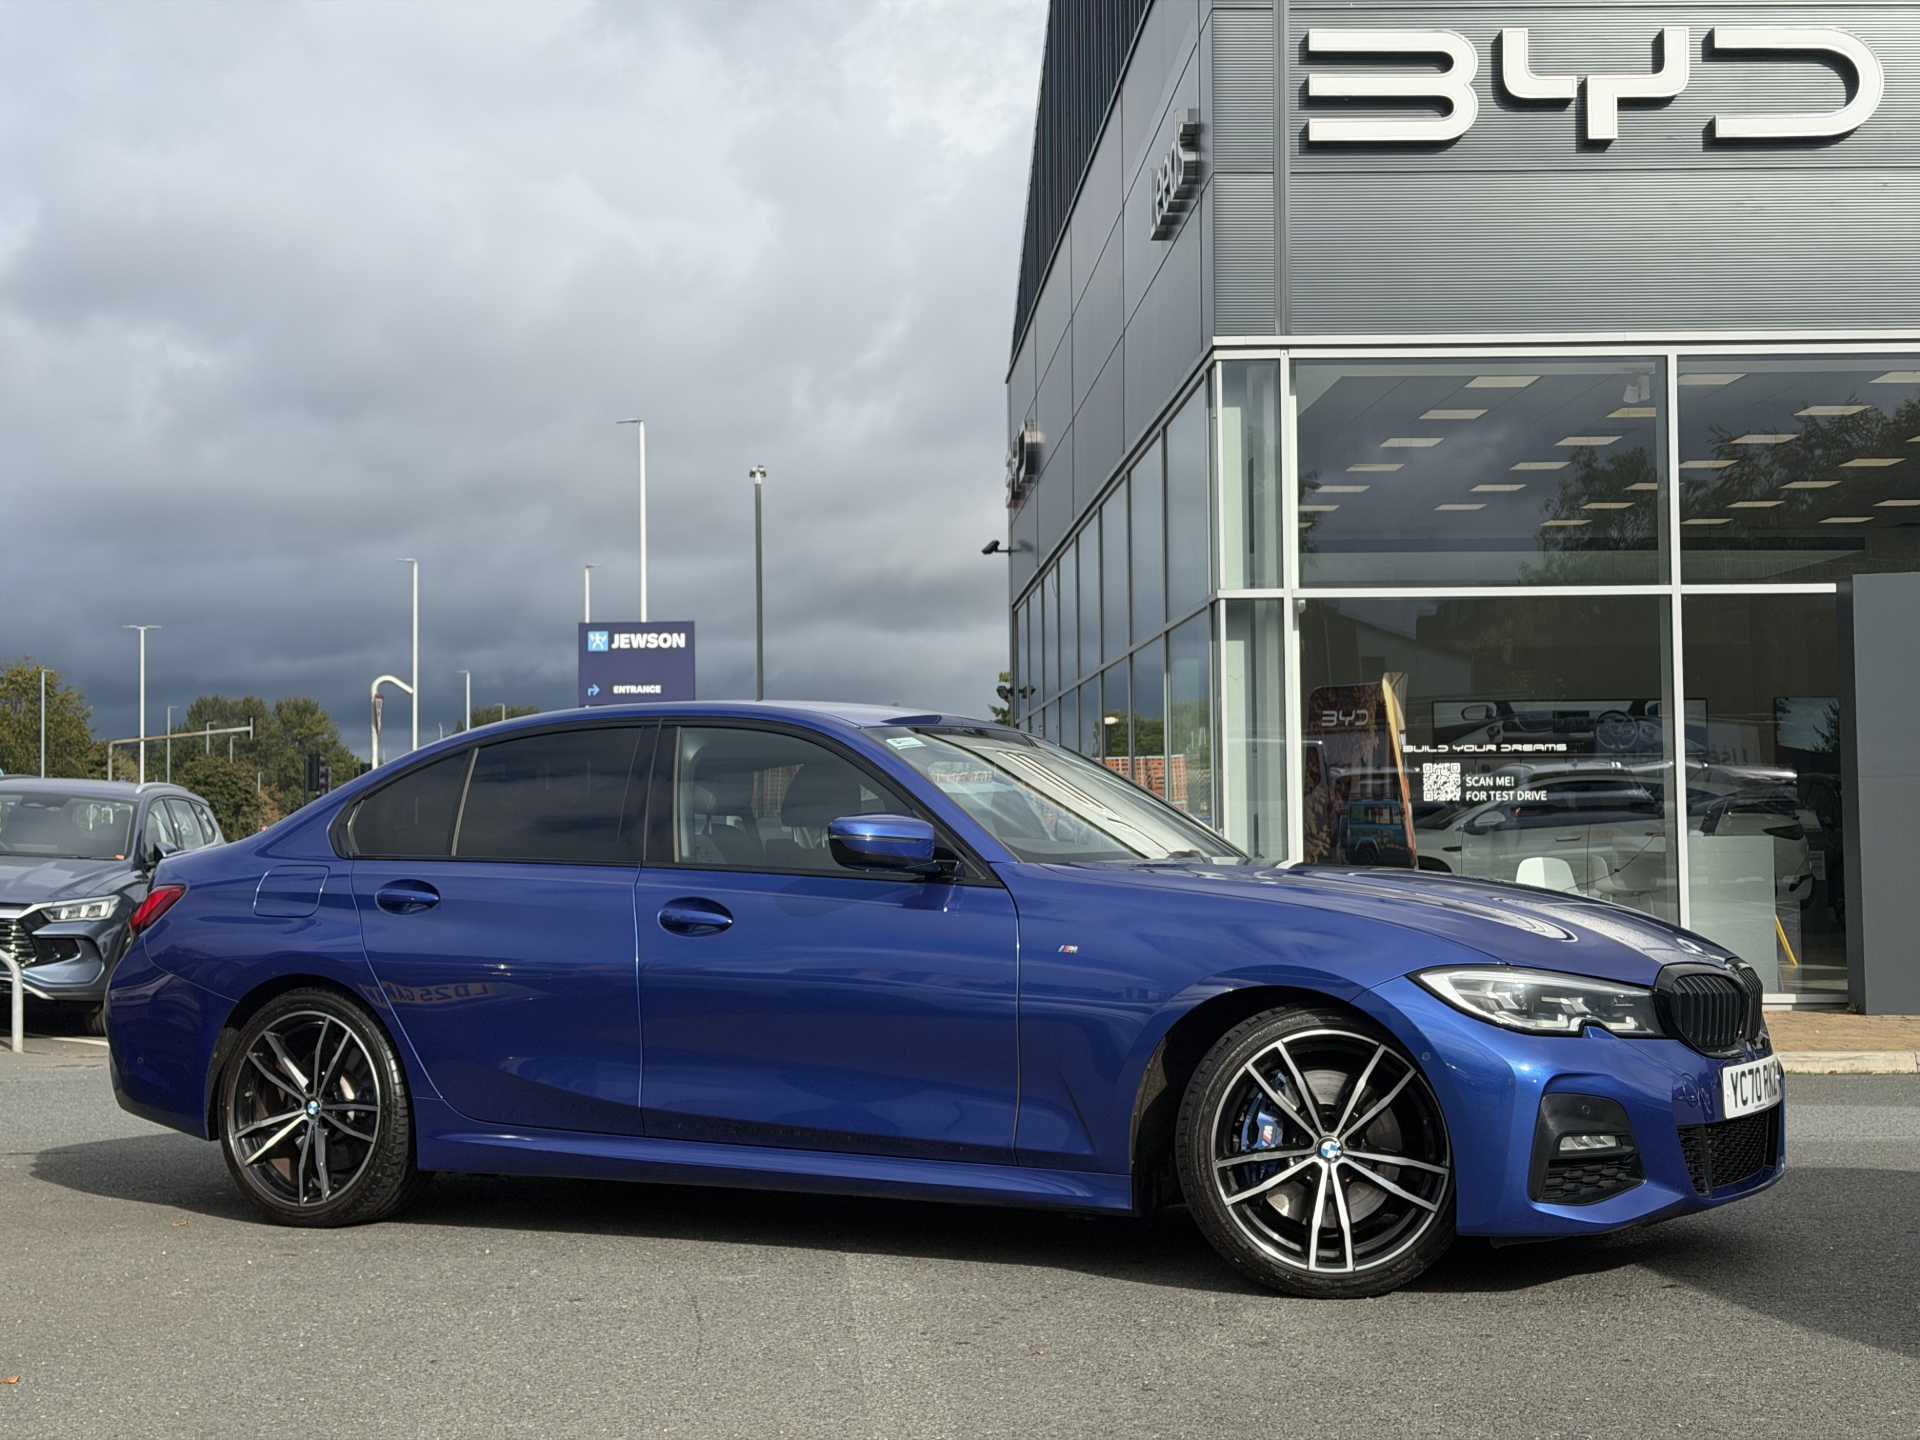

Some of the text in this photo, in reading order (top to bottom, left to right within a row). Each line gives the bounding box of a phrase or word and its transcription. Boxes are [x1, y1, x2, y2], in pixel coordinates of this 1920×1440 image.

[1308, 26, 1885, 142] BYD
[611, 632, 686, 649] JEWSON
[612, 685, 662, 694] ENTRANCE
[1321, 709, 1369, 727] BYD
[1403, 743, 1567, 752] BUILD YOUR DREAMS
[1465, 776, 1515, 787] SCAN ME!
[1465, 790, 1548, 801] FOR TEST DRIVE
[1730, 1066, 1762, 1108] YC70
